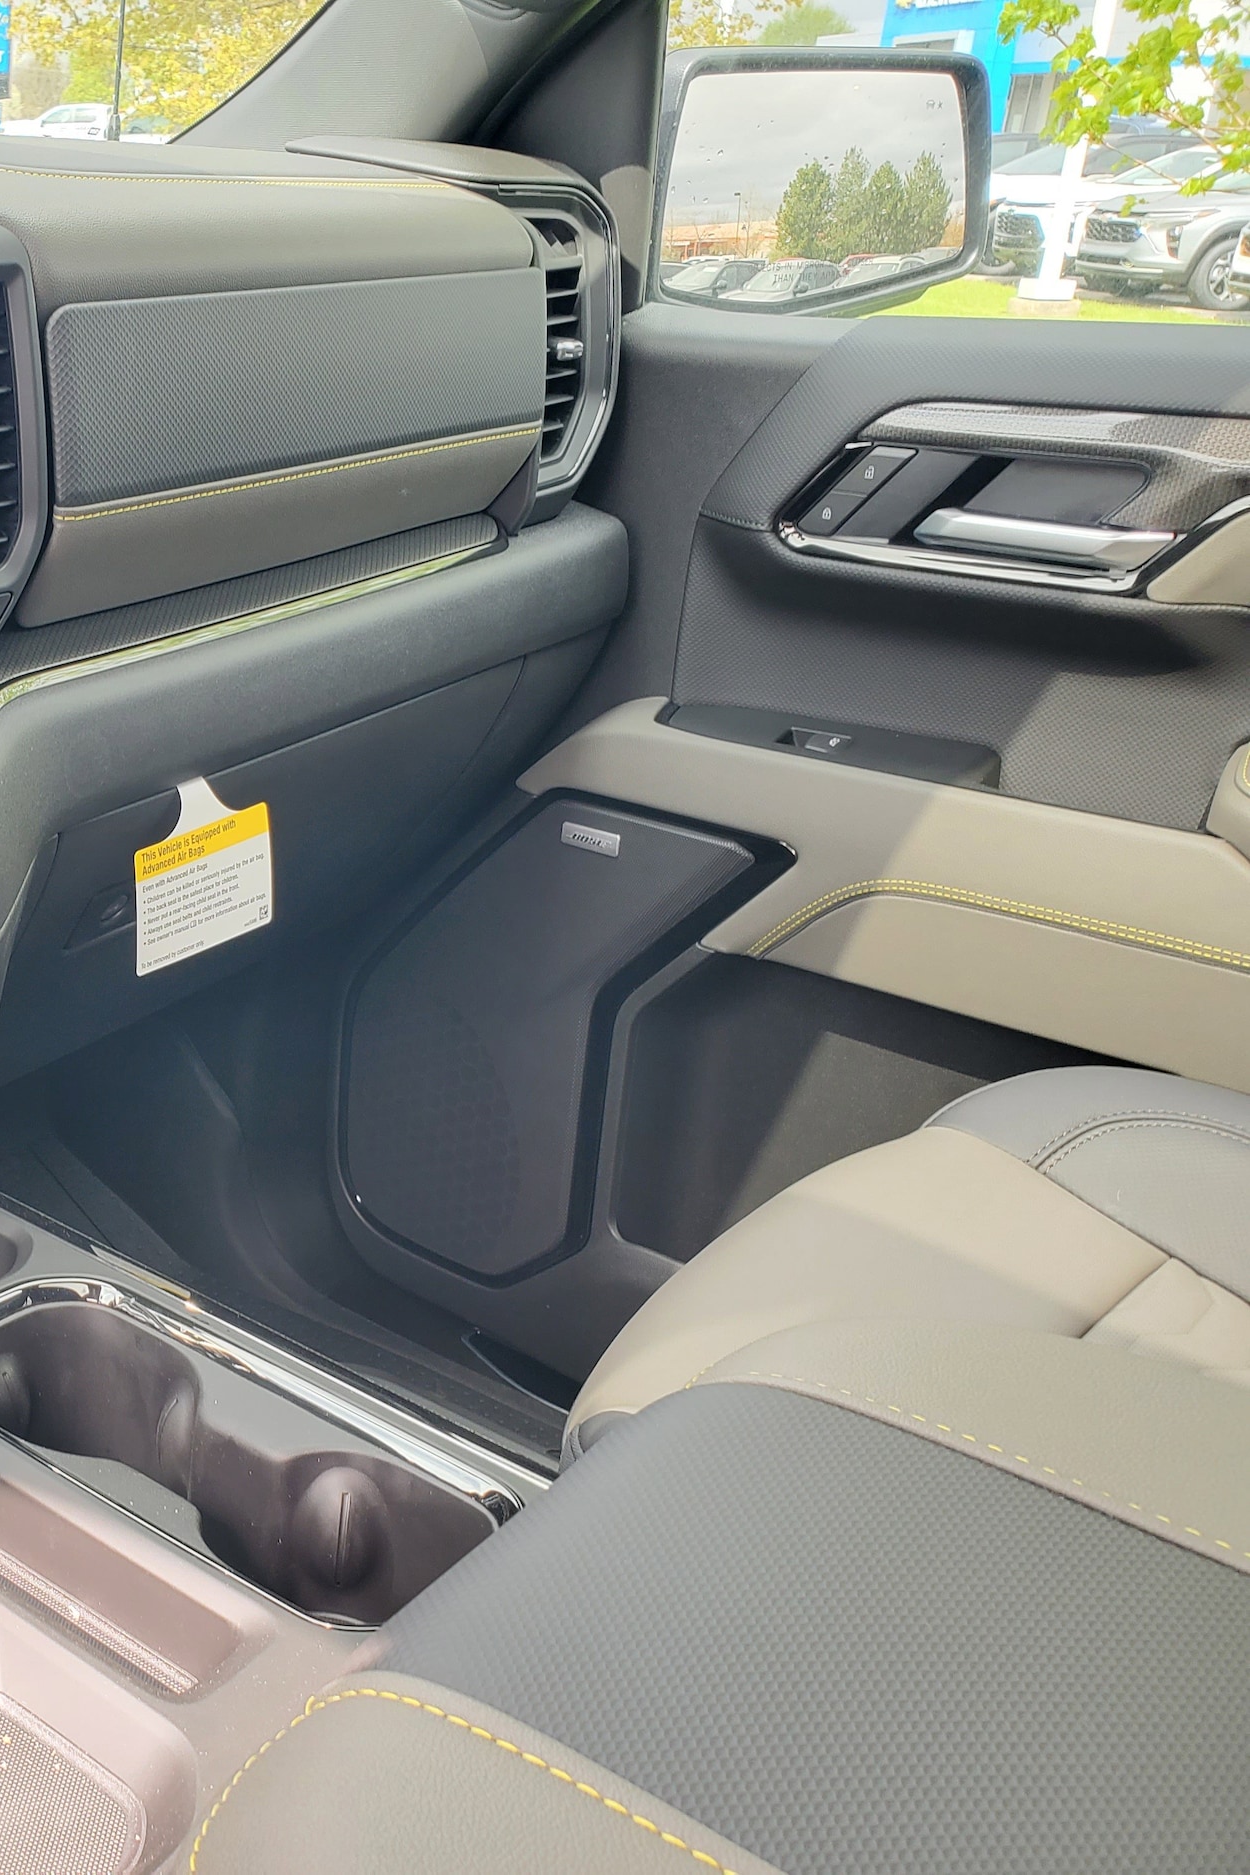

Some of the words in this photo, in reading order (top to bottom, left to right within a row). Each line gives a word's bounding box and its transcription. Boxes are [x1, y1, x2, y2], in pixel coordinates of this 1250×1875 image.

[773, 274, 793, 282] THAN
[141, 850, 156, 863] This
[157, 838, 182, 857] Vehicle
[184, 837, 190, 847] is
[191, 824, 221, 846] Equipped
[222, 820, 236, 831] with
[142, 857, 176, 876] Advanced
[177, 851, 187, 862] Air
[188, 846, 205, 859] Bags
[142, 885, 154, 893] Even
[156, 880, 165, 888] with
[166, 870, 188, 883] Advanced
[197, 863, 208, 872] Bags
[146, 889, 166, 904] Children
[176, 884, 182, 892] be
[183, 880, 194, 890] killed
[201, 871, 220, 883] seriously
[221, 864, 235, 877] injured
[147, 906, 155, 914] The
[156, 901, 166, 910] back
[173, 901, 196, 915] rear-facing
[147, 924, 163, 935] Always
[148, 936, 156, 945] See
[157, 929, 173, 941] owner's
[174, 924, 189, 935] manual
[204, 914, 214, 923] more
[215, 903, 237, 918] information
[239, 899, 249, 908] about
[153, 953, 170, 965] removed
